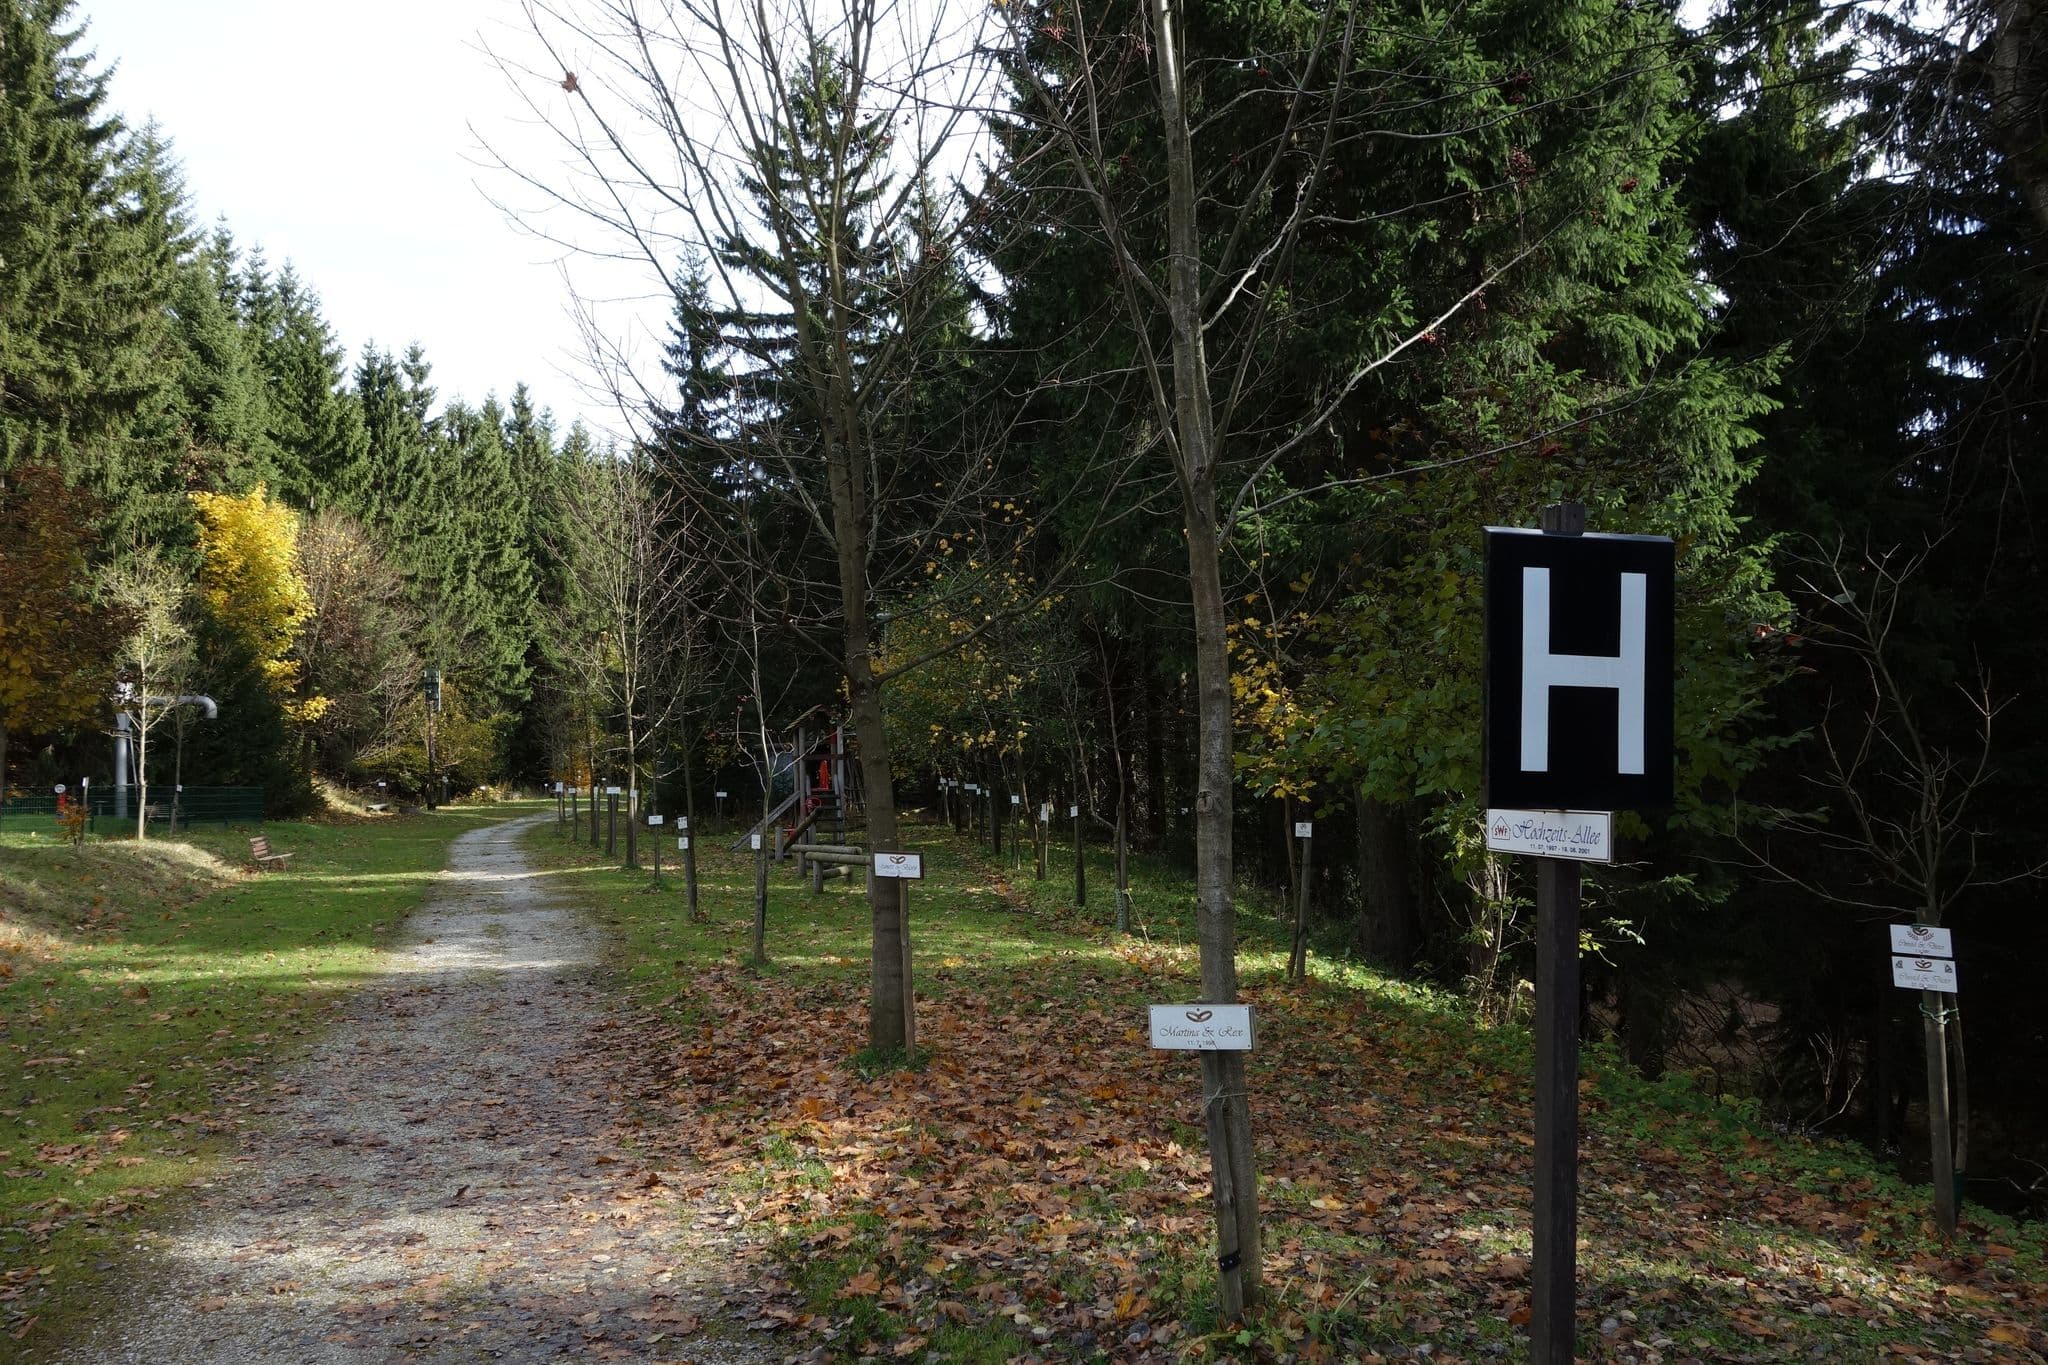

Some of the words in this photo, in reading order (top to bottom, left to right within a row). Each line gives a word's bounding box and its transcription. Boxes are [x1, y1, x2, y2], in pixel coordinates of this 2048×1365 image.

[1520, 567, 1647, 775] H
[1159, 1026, 1200, 1037] Martina
[1202, 1026, 1214, 1037] &
